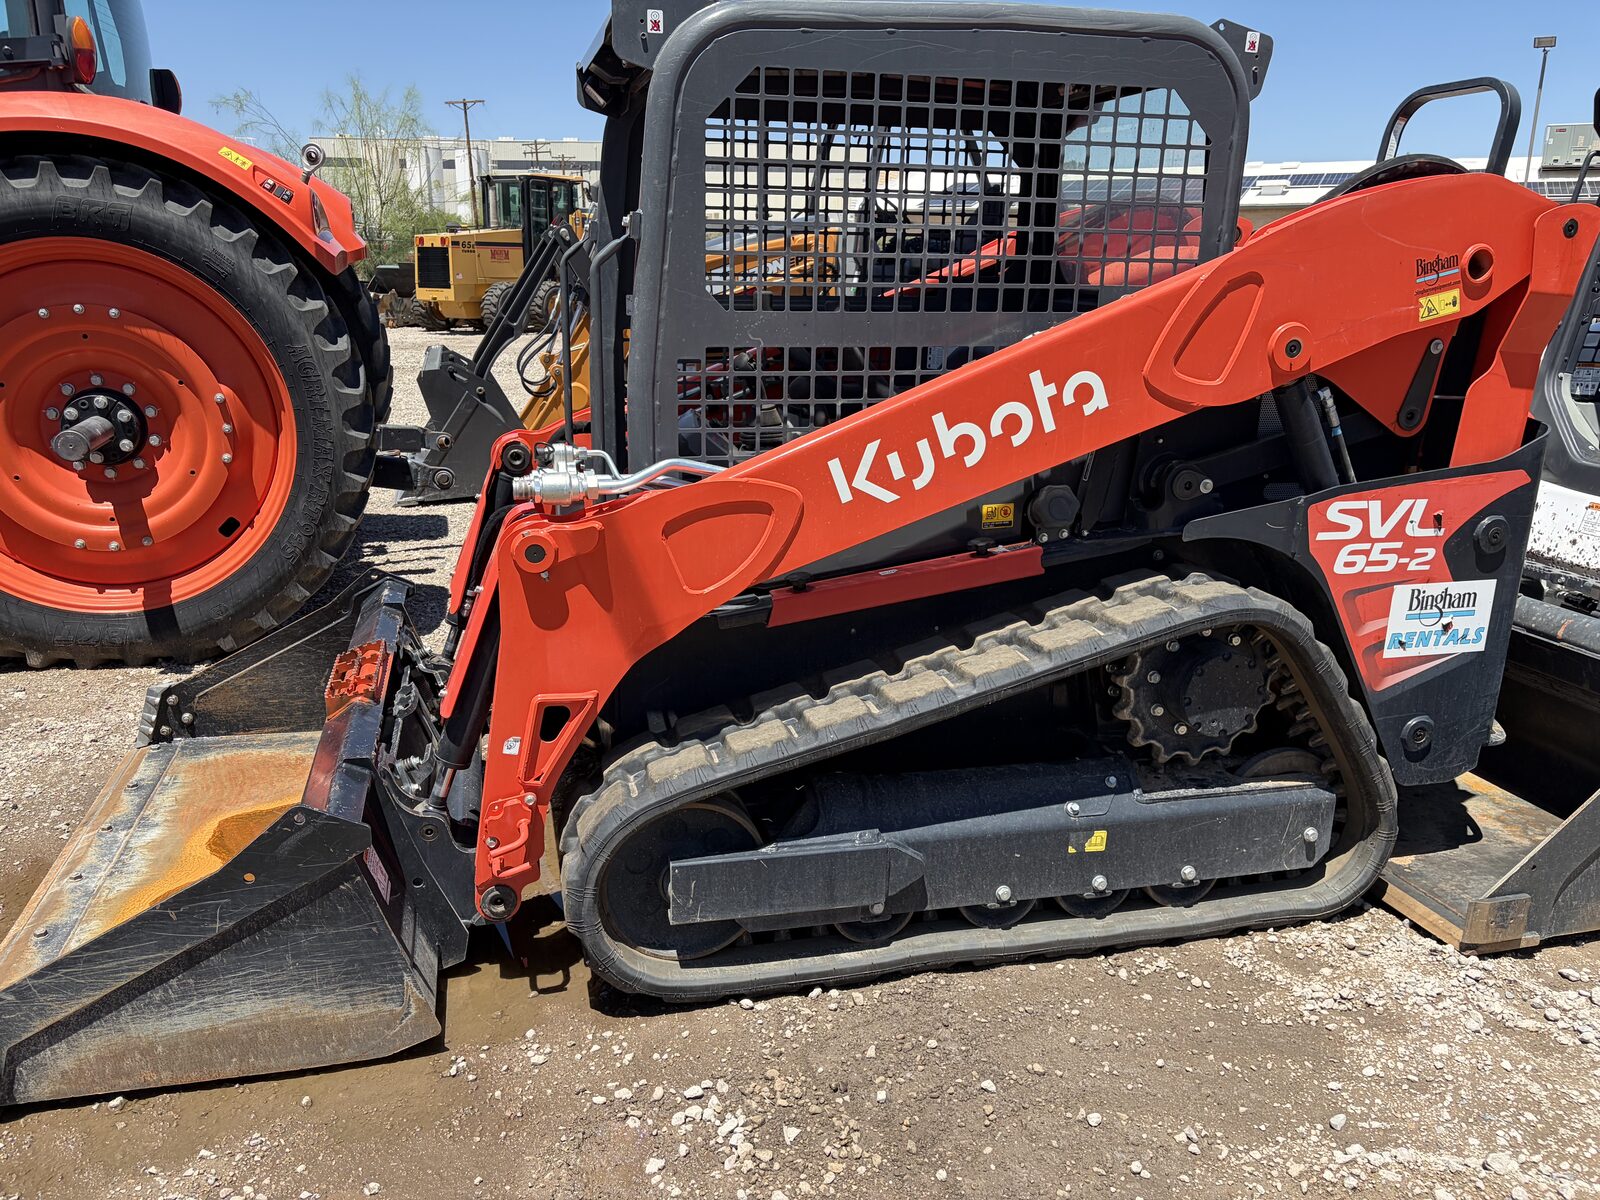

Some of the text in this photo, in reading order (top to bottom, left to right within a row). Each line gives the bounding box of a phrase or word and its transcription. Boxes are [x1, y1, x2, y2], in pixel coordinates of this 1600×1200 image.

[54, 195, 133, 232] BKT
[1416, 254, 1459, 286] Bingham
[827, 369, 1109, 504] Kubota
[1315, 498, 1445, 541] SVL
[1333, 541, 1436, 575] 65-2
[1407, 586, 1477, 627] Bingham
[1387, 626, 1486, 650] RENTALS
